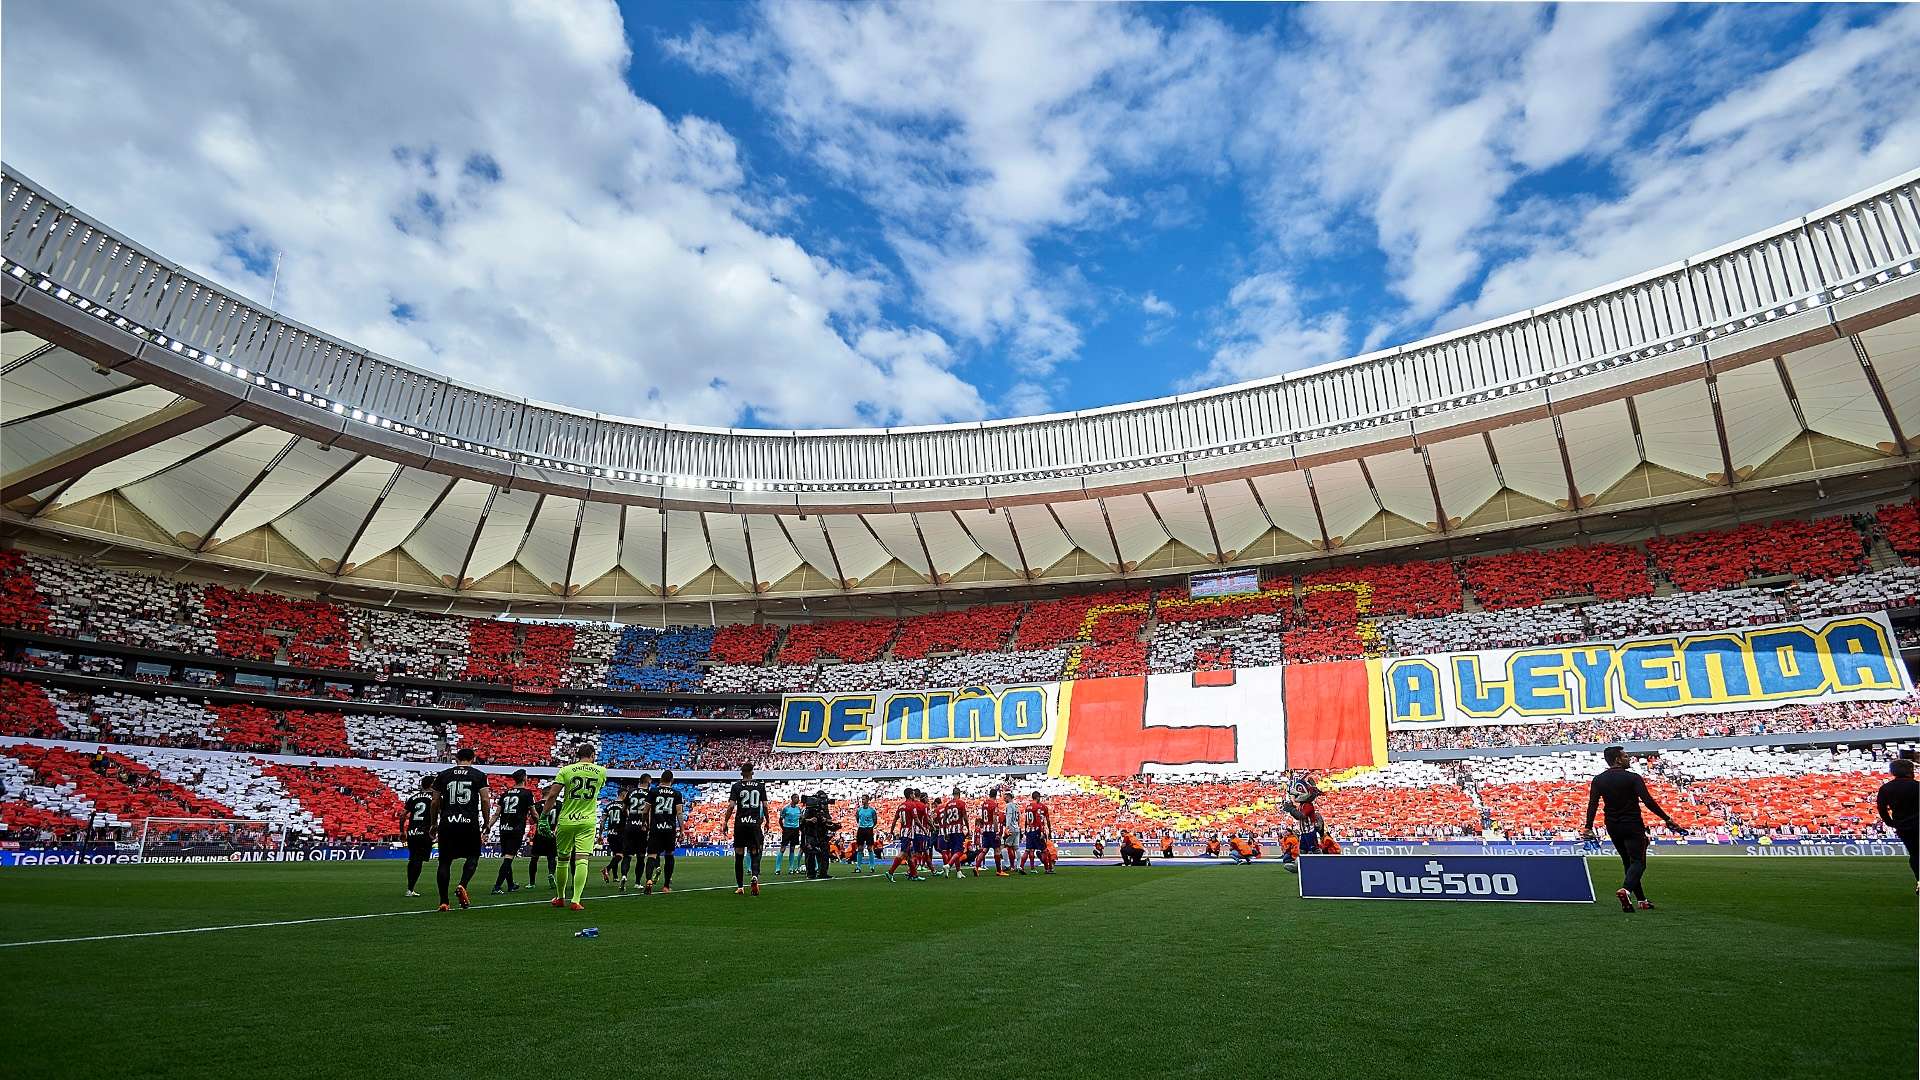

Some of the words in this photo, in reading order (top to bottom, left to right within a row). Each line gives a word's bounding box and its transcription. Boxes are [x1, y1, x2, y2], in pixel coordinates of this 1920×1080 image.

[1386, 658, 1445, 723] A
[1450, 611, 1905, 719] LEYENDA
[776, 694, 876, 747] DE
[881, 685, 1047, 745] NIÑO
[447, 780, 472, 805] 15
[569, 776, 598, 800] 25
[503, 795, 520, 814] 12
[655, 796, 675, 815] 24
[740, 789, 760, 809] 20
[413, 801, 426, 821] 2
[447, 814, 471, 823] Wiko
[947, 807, 960, 824] 23
[185, 855, 229, 863] AIRLINES
[349, 850, 365, 861] TV
[1746, 845, 1835, 856] SAMSUNG
[1360, 870, 1519, 895] Plus500
